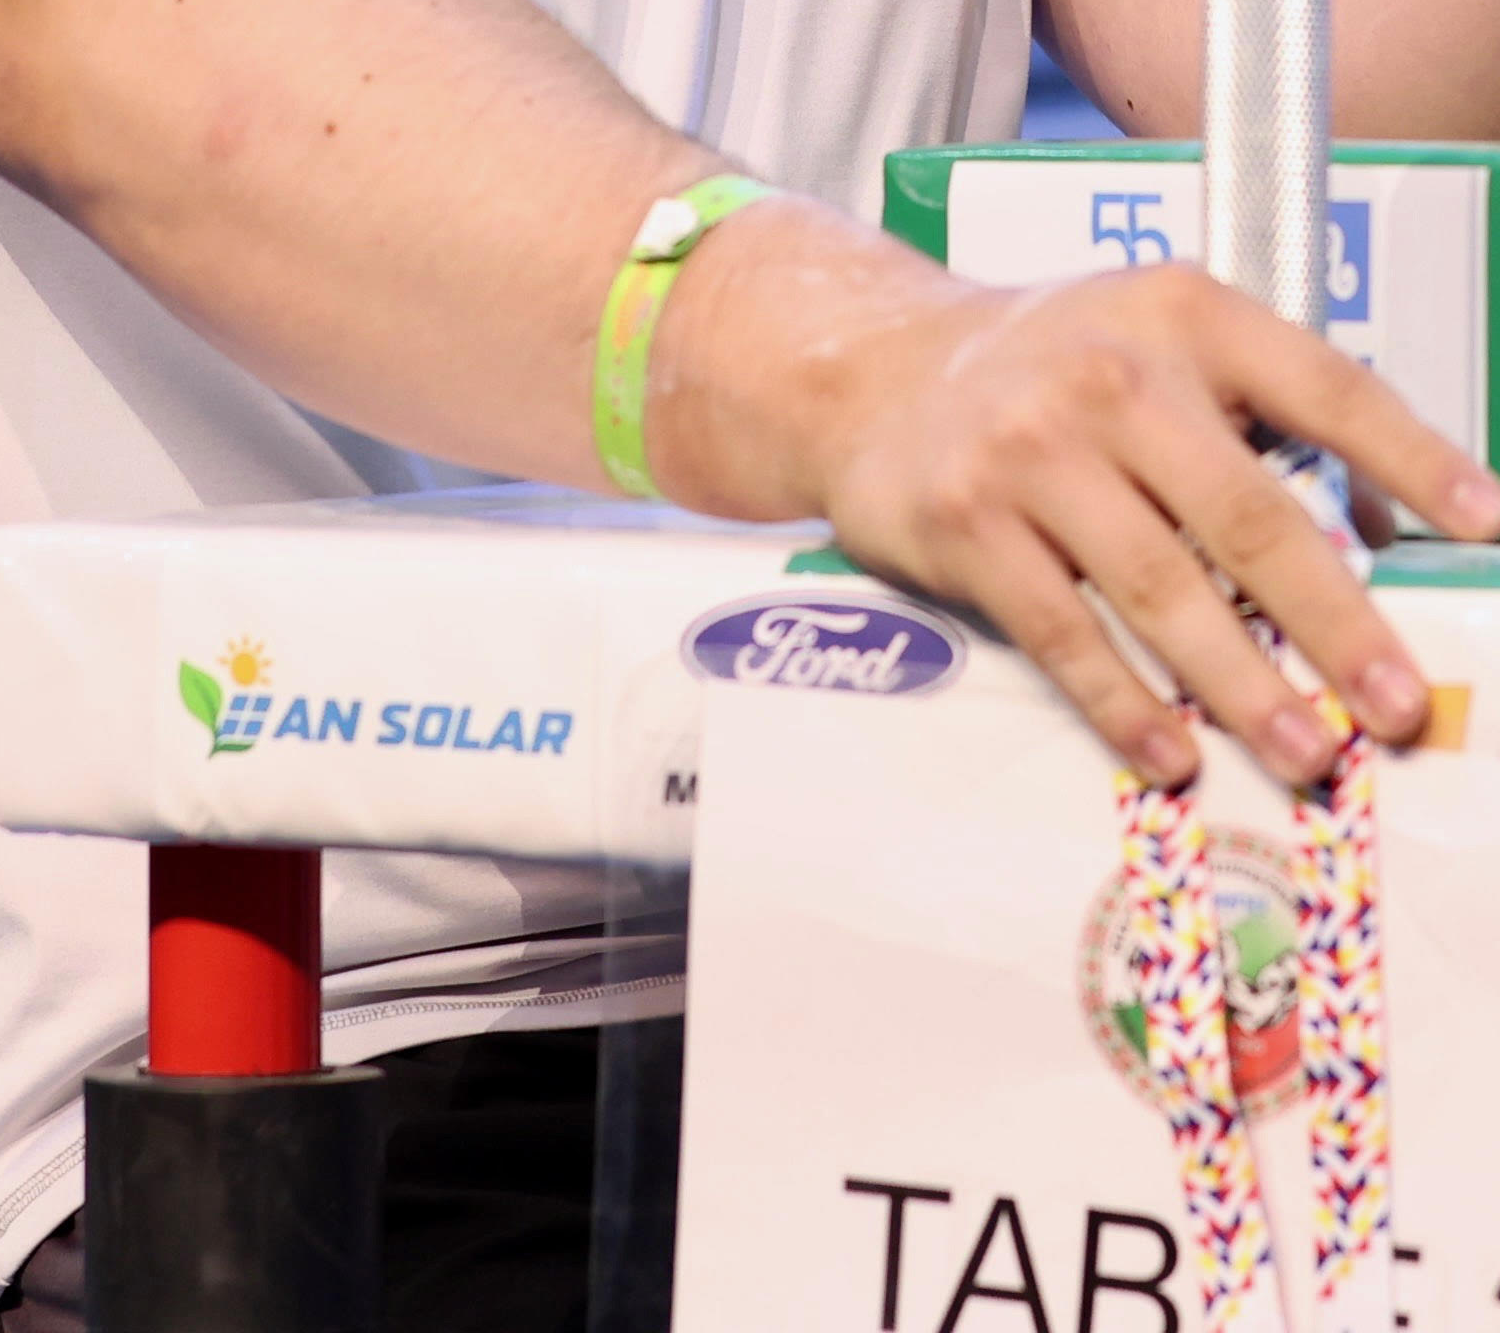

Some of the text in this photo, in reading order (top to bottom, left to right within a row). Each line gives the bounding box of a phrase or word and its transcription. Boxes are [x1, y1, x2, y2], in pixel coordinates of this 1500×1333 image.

[732, 605, 912, 693] Ford
[375, 703, 575, 756] SOLAR
[843, 1176, 1422, 1333] TAB
